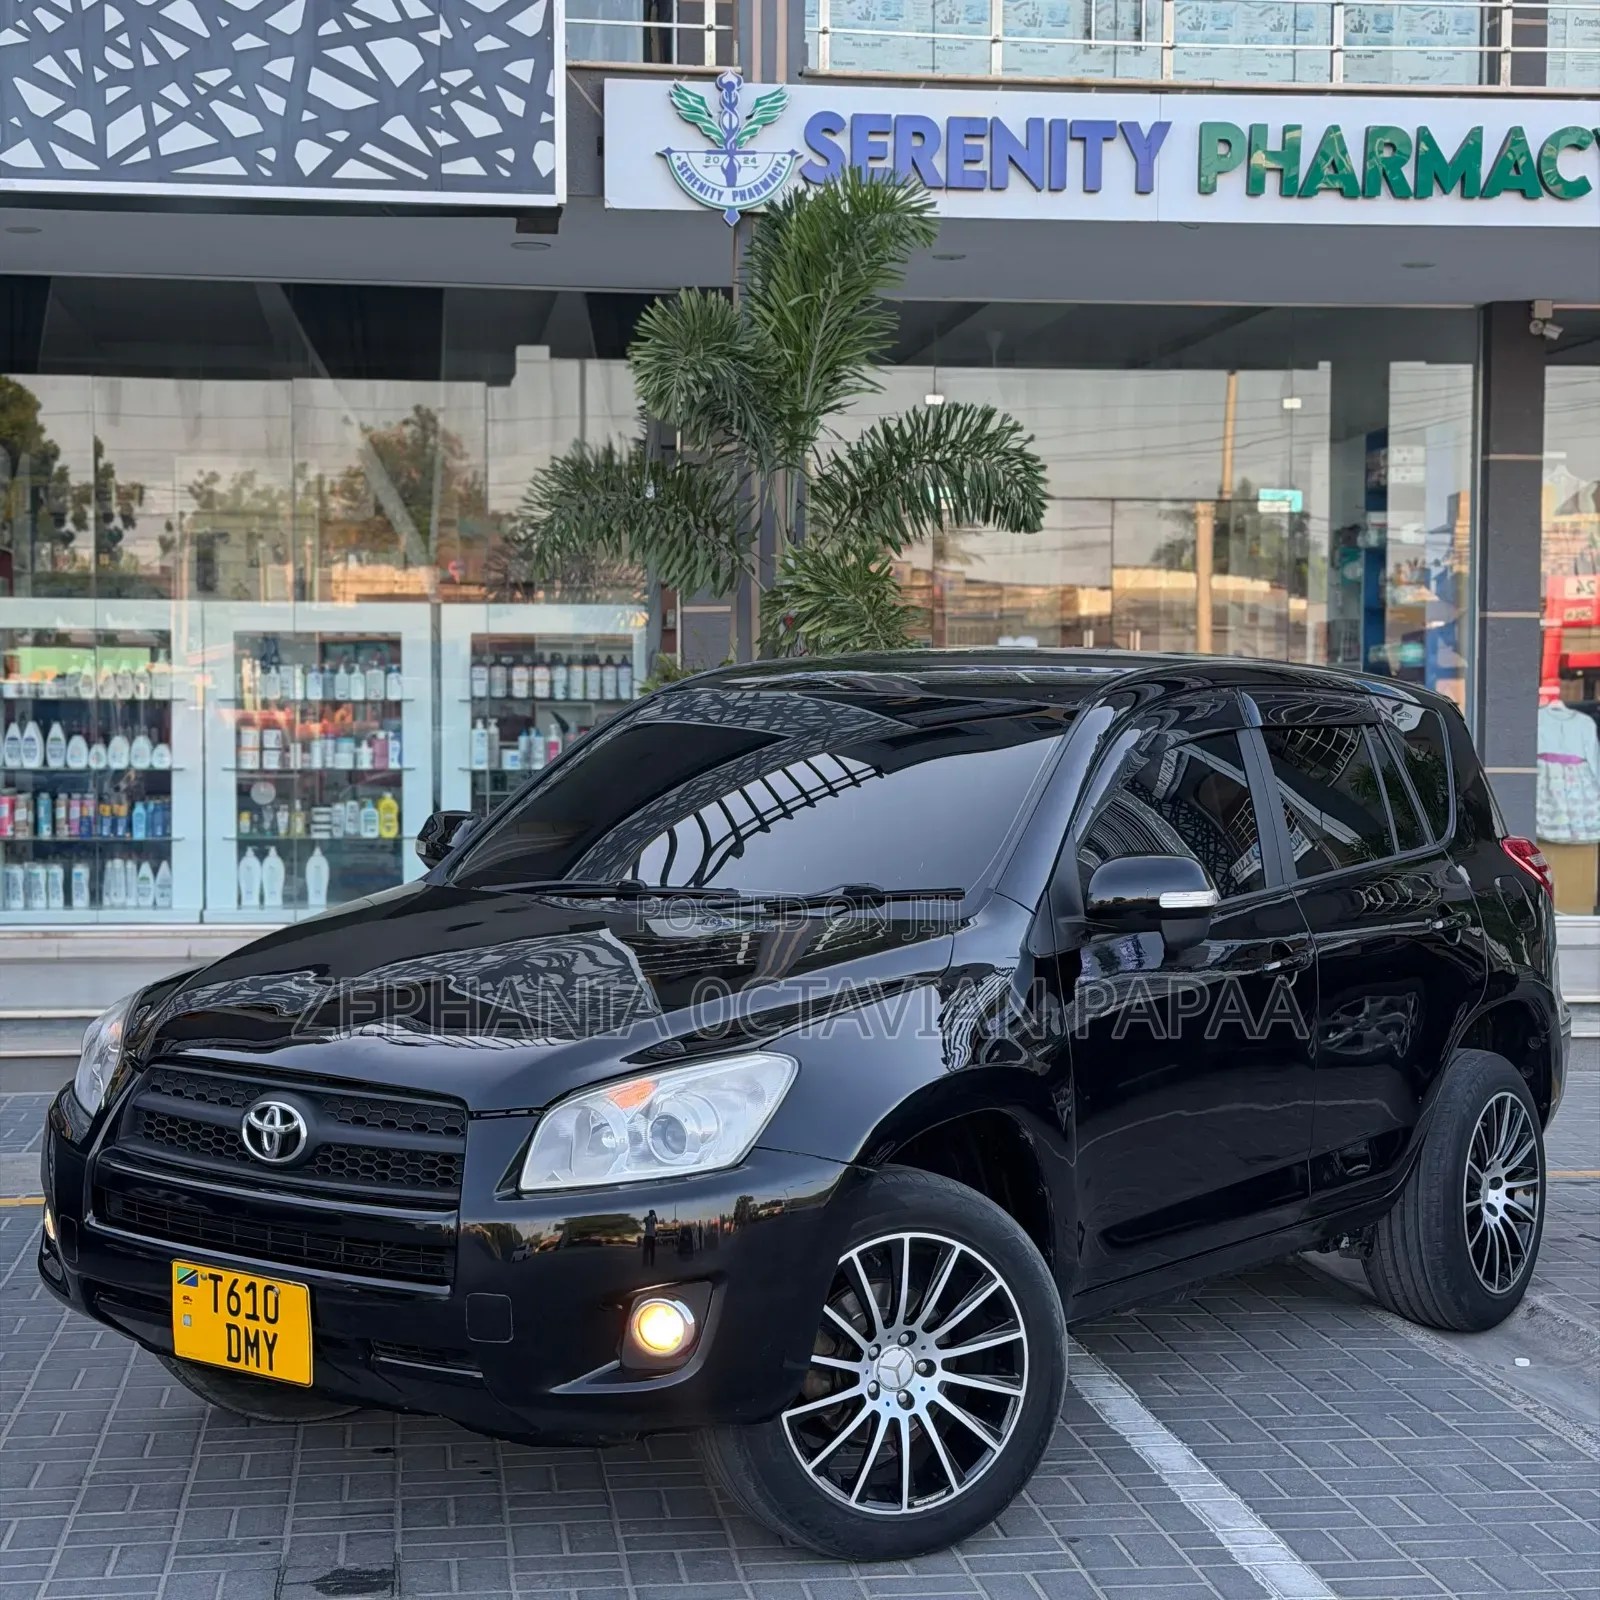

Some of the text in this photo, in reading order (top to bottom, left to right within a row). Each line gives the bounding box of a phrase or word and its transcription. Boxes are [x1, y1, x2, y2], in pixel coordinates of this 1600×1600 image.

[704, 156, 758, 165] 20 24
[800, 111, 1600, 200] SERENITY PHARMAC
[677, 161, 786, 202] SERENITY PHARMACY
[208, 1273, 279, 1324] T610
[225, 1322, 278, 1372] DMY
